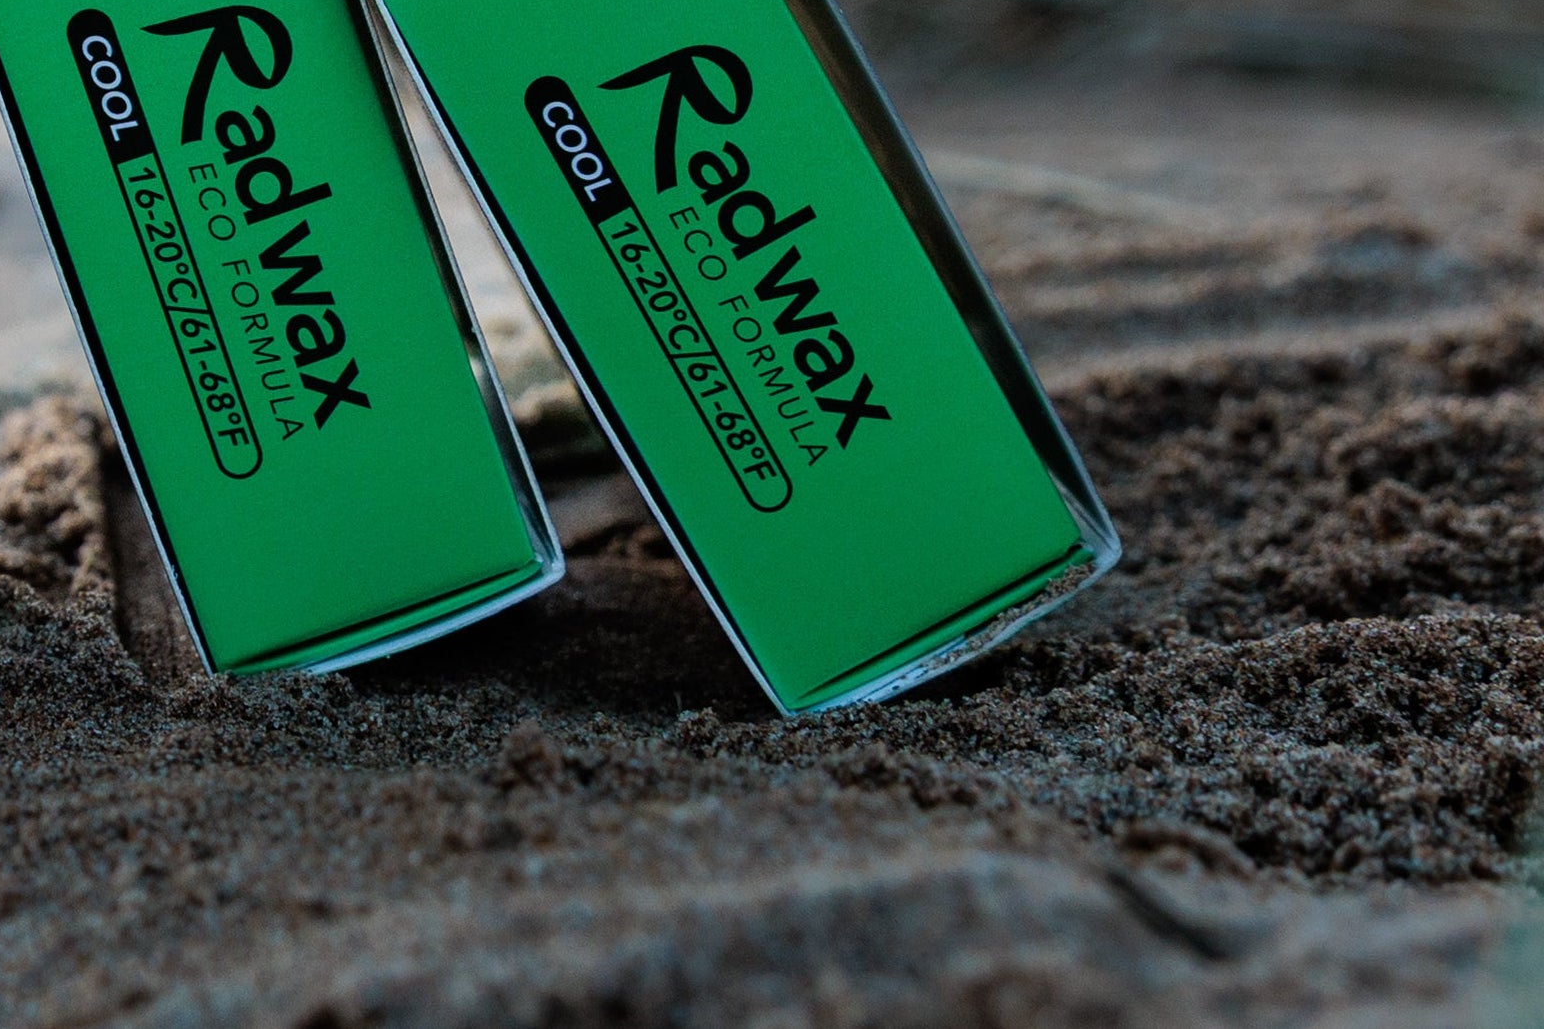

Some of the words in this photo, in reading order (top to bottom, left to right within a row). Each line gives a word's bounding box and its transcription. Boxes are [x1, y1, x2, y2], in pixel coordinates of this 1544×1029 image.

[81, 35, 139, 142] COOL
[140, 5, 372, 430] Radwax
[542, 100, 612, 202] COOL
[188, 162, 236, 241] ECO
[221, 258, 305, 441] FORMULA
[596, 44, 892, 449] Radwax
[669, 206, 727, 281] ECO
[719, 295, 829, 466] FORMULA
